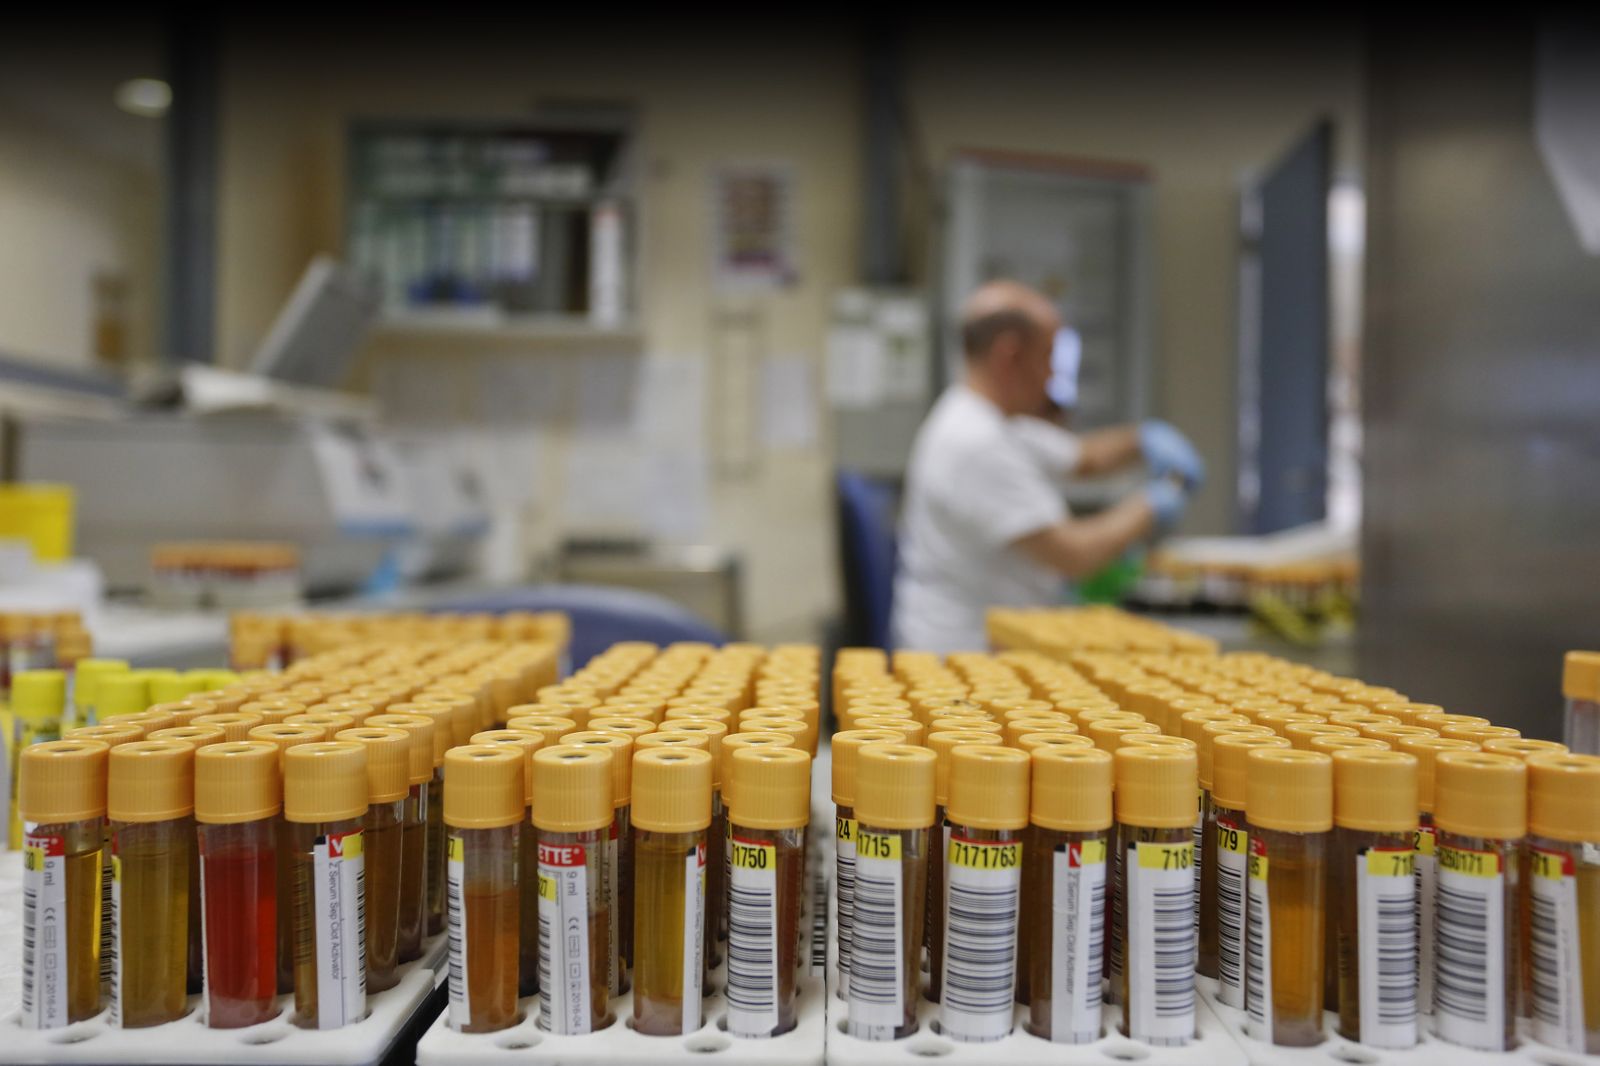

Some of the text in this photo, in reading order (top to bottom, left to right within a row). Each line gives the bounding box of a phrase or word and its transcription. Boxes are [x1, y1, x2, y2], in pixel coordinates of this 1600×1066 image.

[836, 817, 850, 839] 24
[857, 831, 890, 858] 1715
[955, 842, 1017, 868] 7171763
[329, 871, 338, 900] Serum
[328, 902, 338, 920] Sep
